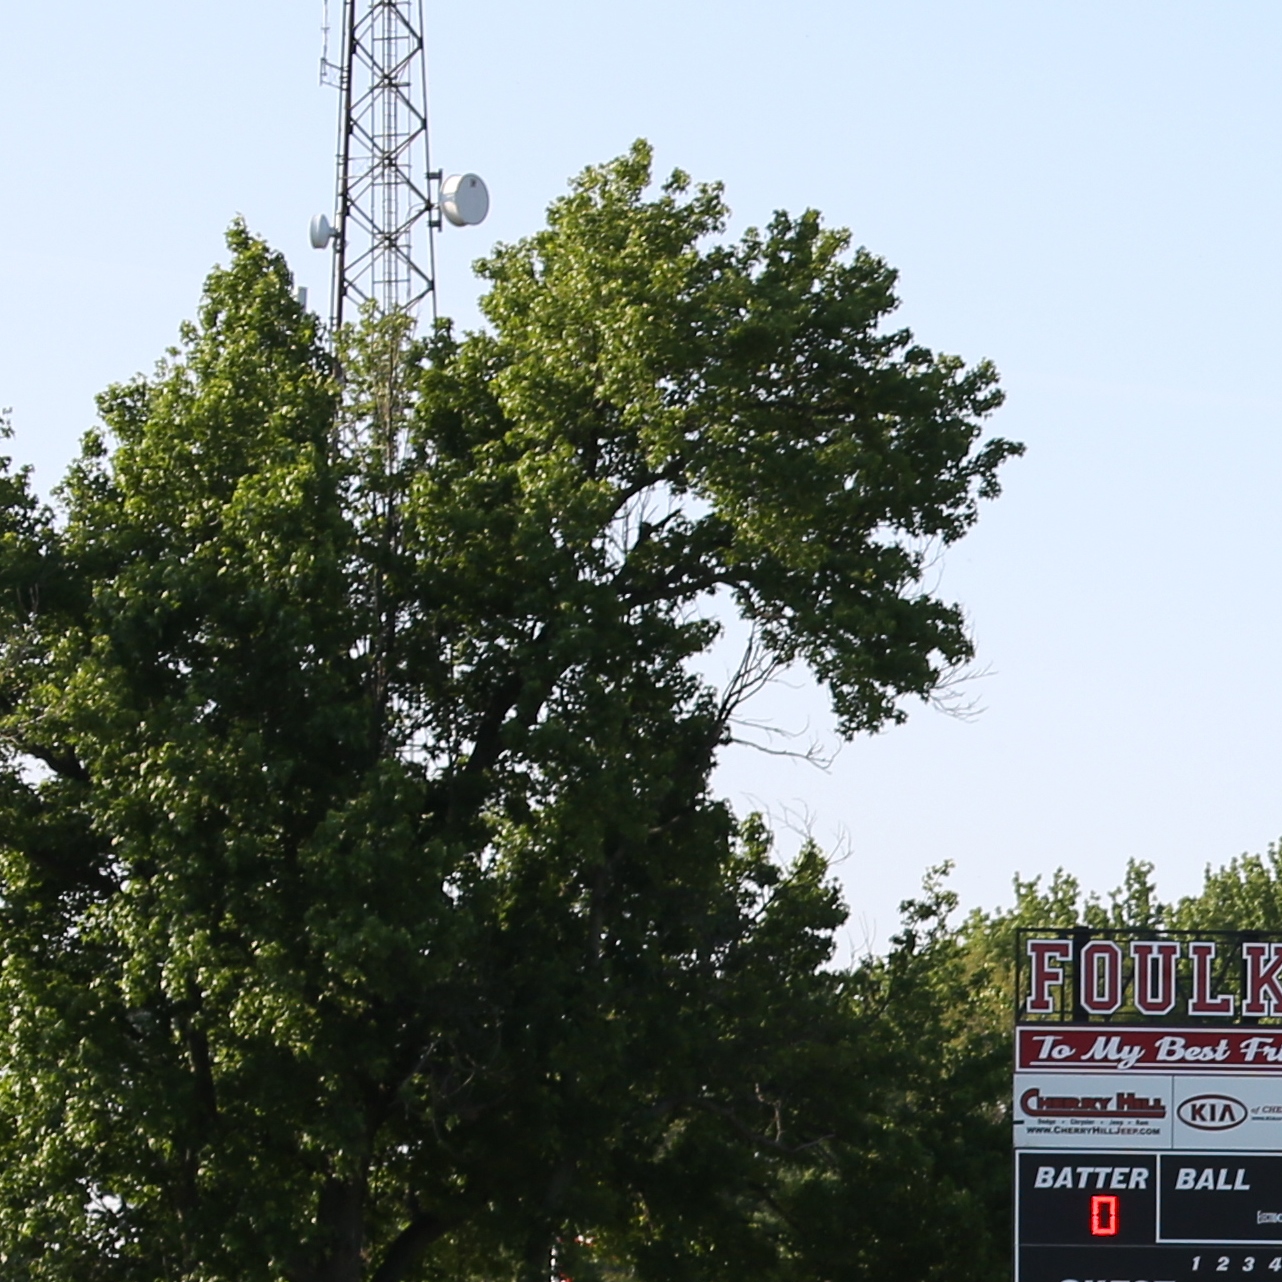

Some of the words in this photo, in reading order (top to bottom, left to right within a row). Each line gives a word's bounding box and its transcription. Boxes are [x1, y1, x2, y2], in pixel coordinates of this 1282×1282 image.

[1031, 1034, 1075, 1060] To
[1081, 1035, 1145, 1070] My
[1156, 1037, 1230, 1063] Best
[1020, 1087, 1114, 1117] CHERRY
[1116, 1092, 1166, 1111] HILL
[1190, 1103, 1237, 1122] KIA
[1250, 1105, 1260, 1114] of
[1034, 1166, 1148, 1189] BATTER
[1175, 1168, 1250, 1190] BALL
[1092, 1196, 1117, 1235] 0
[1191, 1256, 1201, 1272] 1
[1216, 1256, 1229, 1272] 2
[1242, 1256, 1255, 1272] 3
[1268, 1256, 1281, 1272] 4
